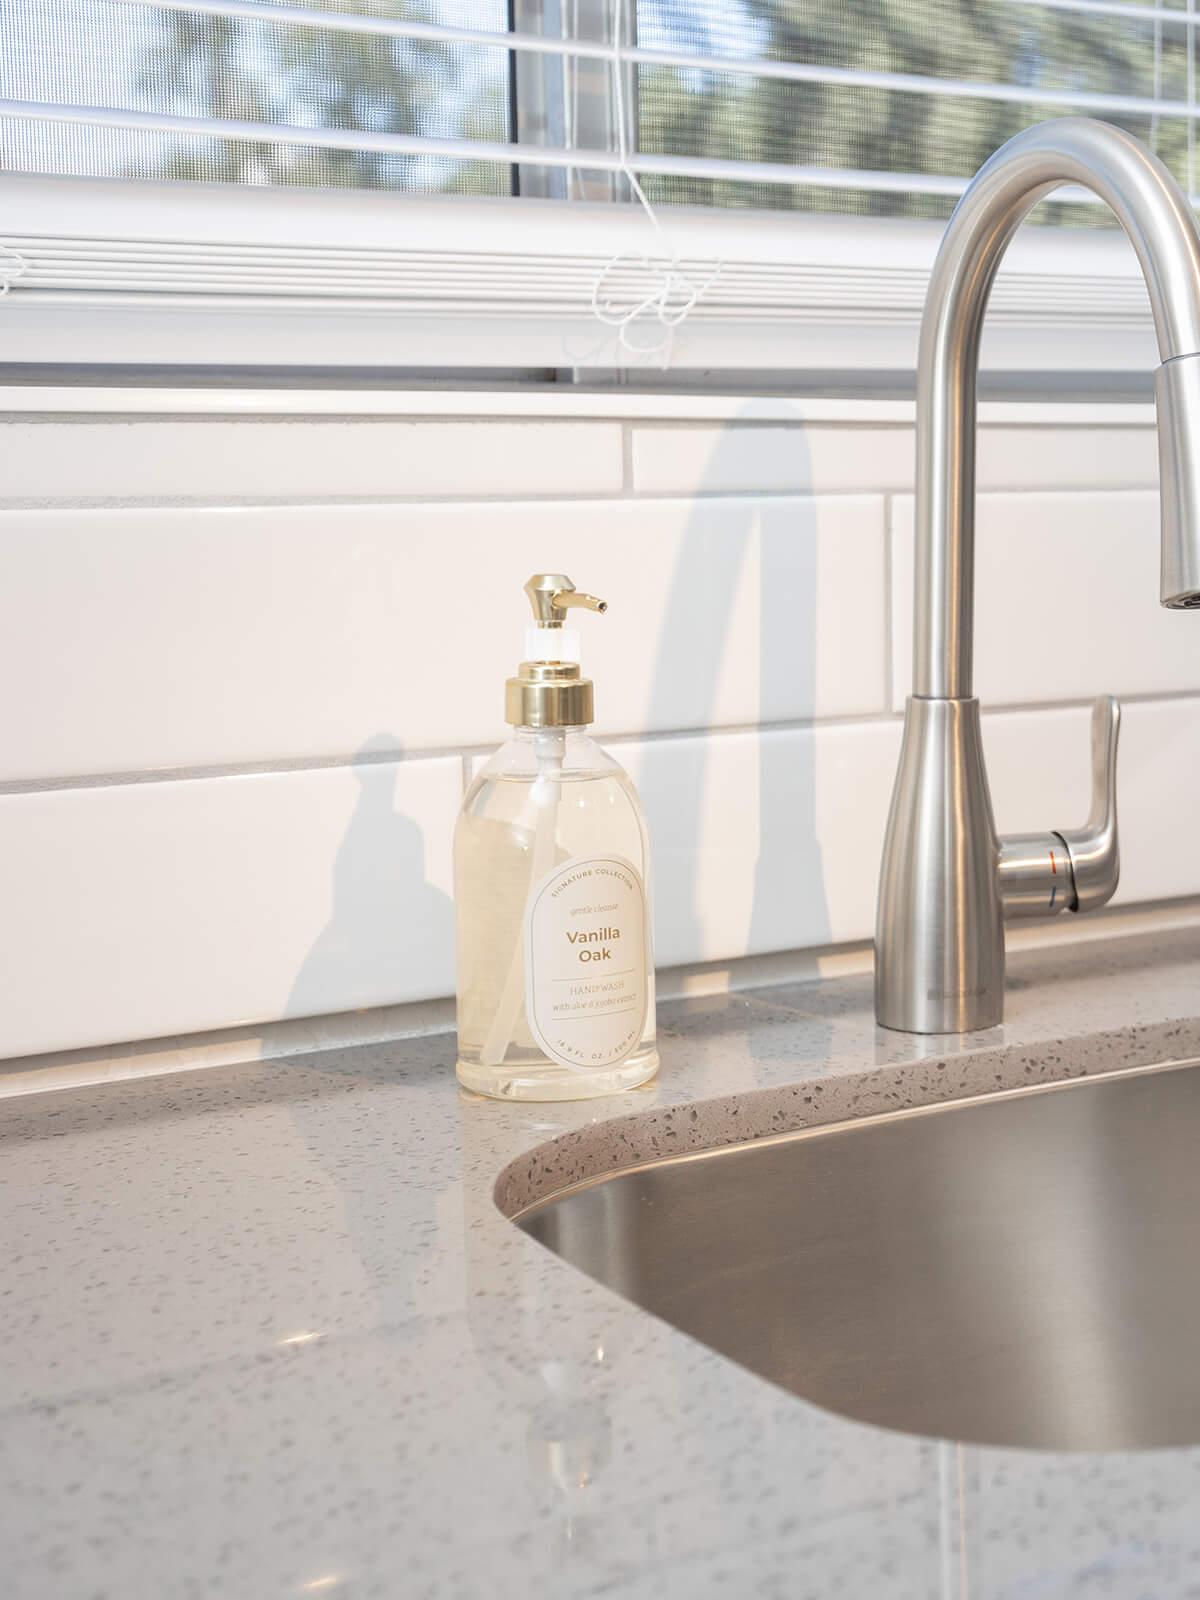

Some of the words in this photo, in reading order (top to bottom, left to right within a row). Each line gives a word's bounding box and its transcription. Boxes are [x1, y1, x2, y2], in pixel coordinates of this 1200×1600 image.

[551, 869, 592, 898] SIGNATURE
[595, 868, 633, 891] COLLECTION
[570, 904, 592, 917] gentle
[566, 927, 620, 945] Vanilla
[578, 947, 612, 963] Oak
[552, 1001, 570, 1012] with
[571, 1000, 587, 1010] aloe
